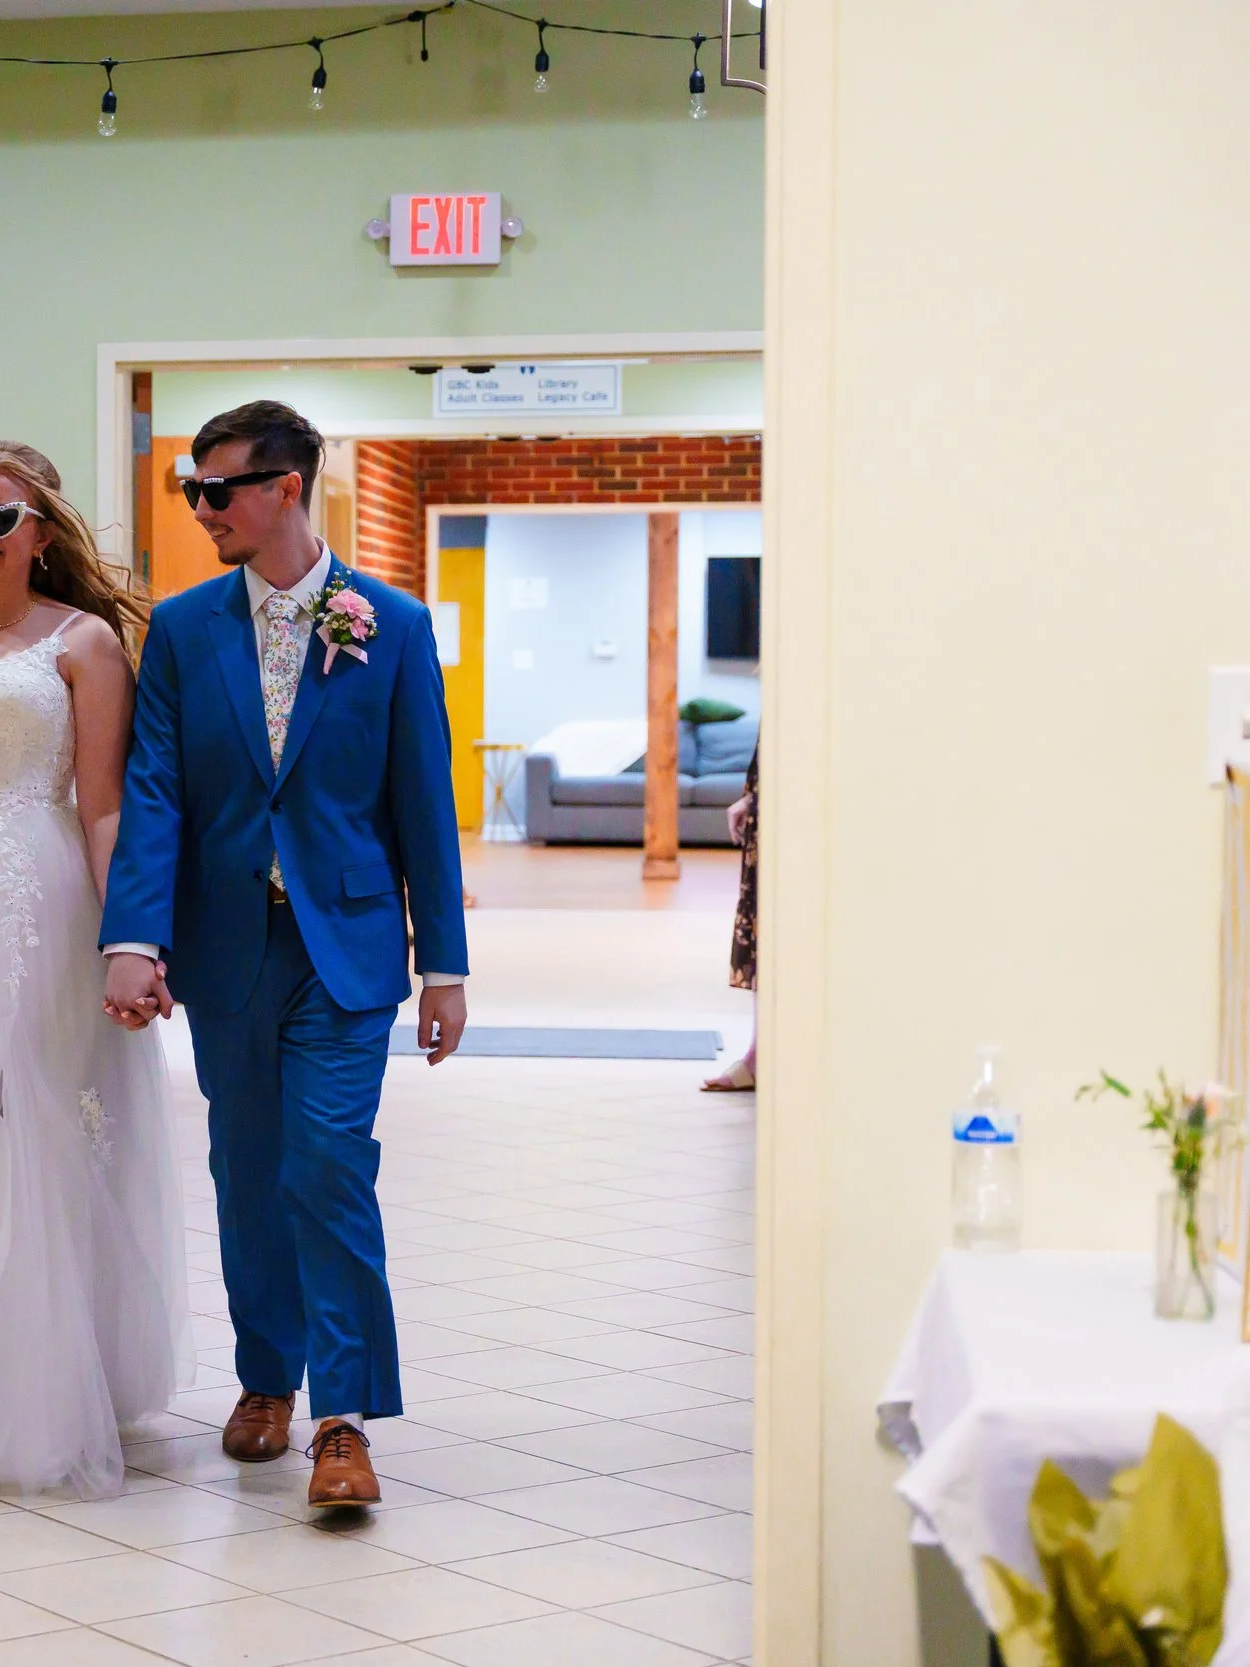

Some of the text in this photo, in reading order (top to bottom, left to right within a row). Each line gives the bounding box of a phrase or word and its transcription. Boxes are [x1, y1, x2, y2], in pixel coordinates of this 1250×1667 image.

[410, 194, 487, 256] EXIT
[448, 379, 500, 390] GBC Kids
[537, 379, 579, 391] Library
[448, 392, 524, 403] Adult Classes
[537, 391, 579, 403] Legacy
